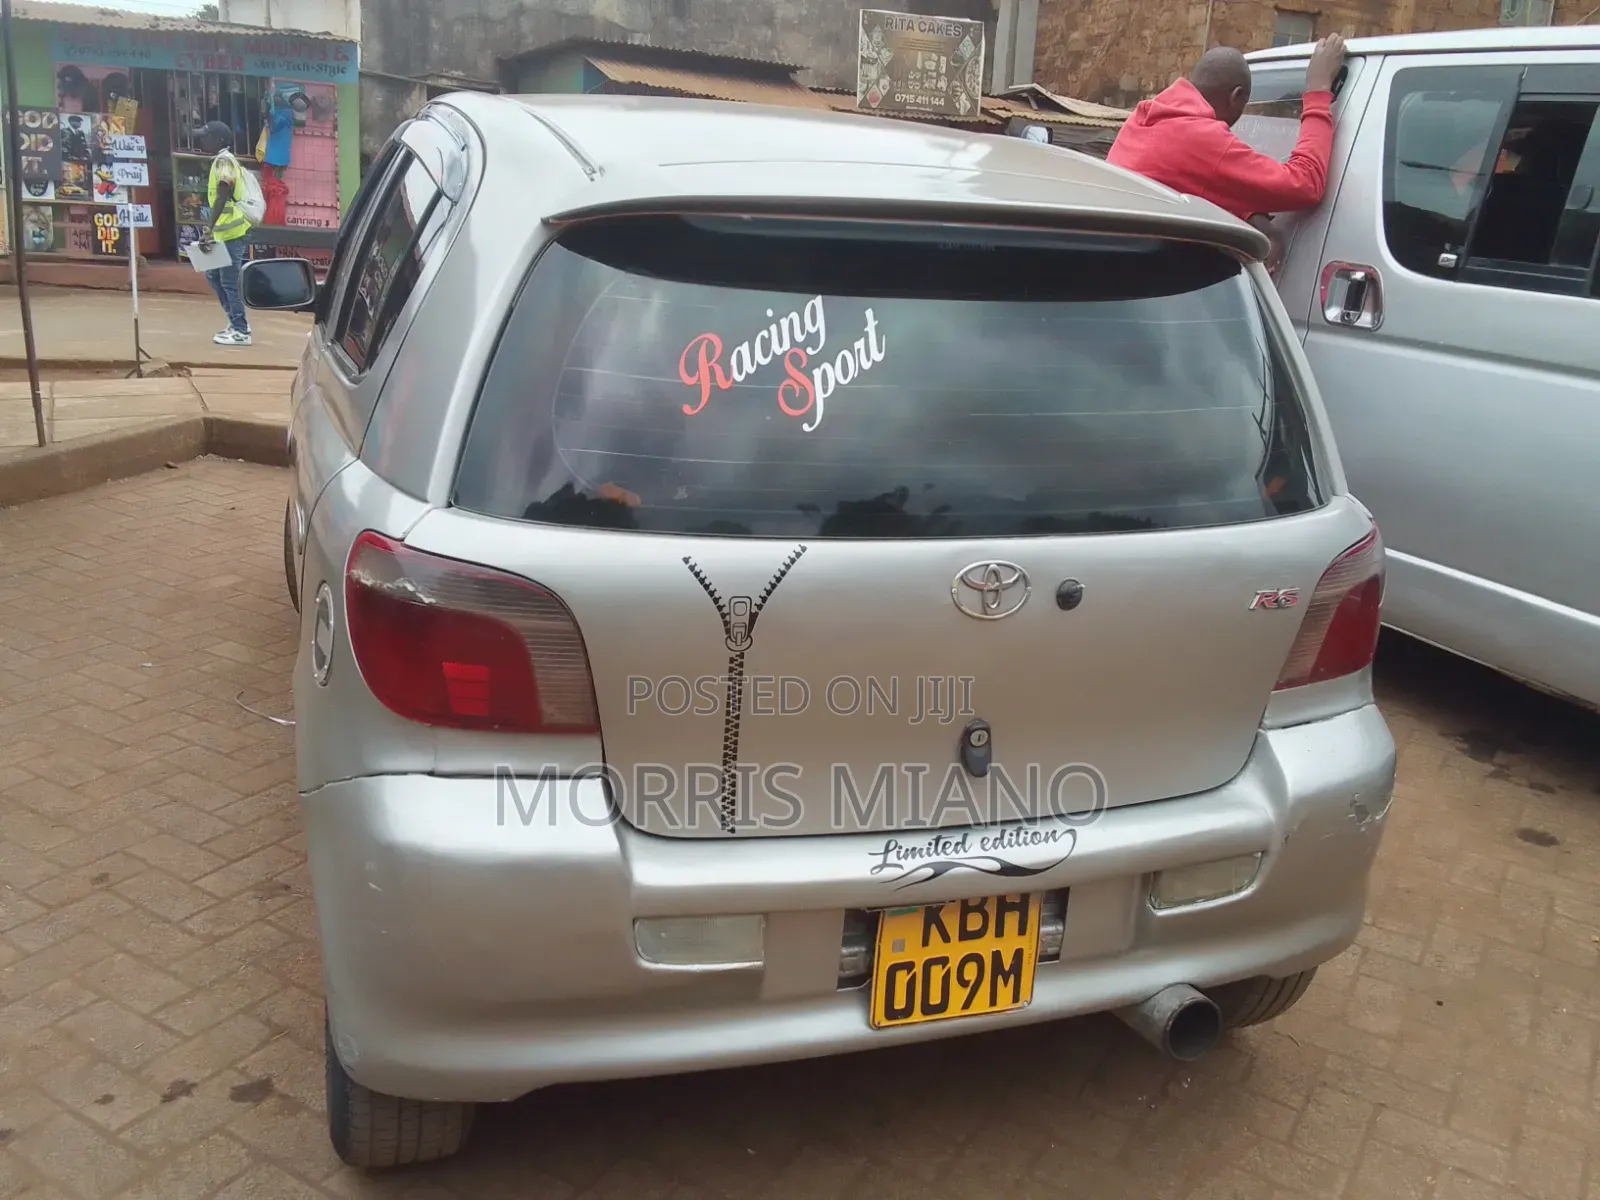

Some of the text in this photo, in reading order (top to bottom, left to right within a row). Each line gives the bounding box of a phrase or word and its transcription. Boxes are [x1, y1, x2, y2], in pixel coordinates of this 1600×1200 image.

[884, 15, 963, 38] RITA CAKES
[895, 93, 945, 107] 0715 411 144
[112, 139, 145, 154] Wake up
[117, 168, 142, 183] Pray
[97, 226, 120, 241] DID
[101, 239, 117, 253] IT.
[679, 294, 826, 416] Racing
[777, 307, 887, 432] Sport
[868, 825, 1068, 876] Limited edition
[922, 892, 1031, 948] KBH
[884, 947, 1024, 1021] 009M
